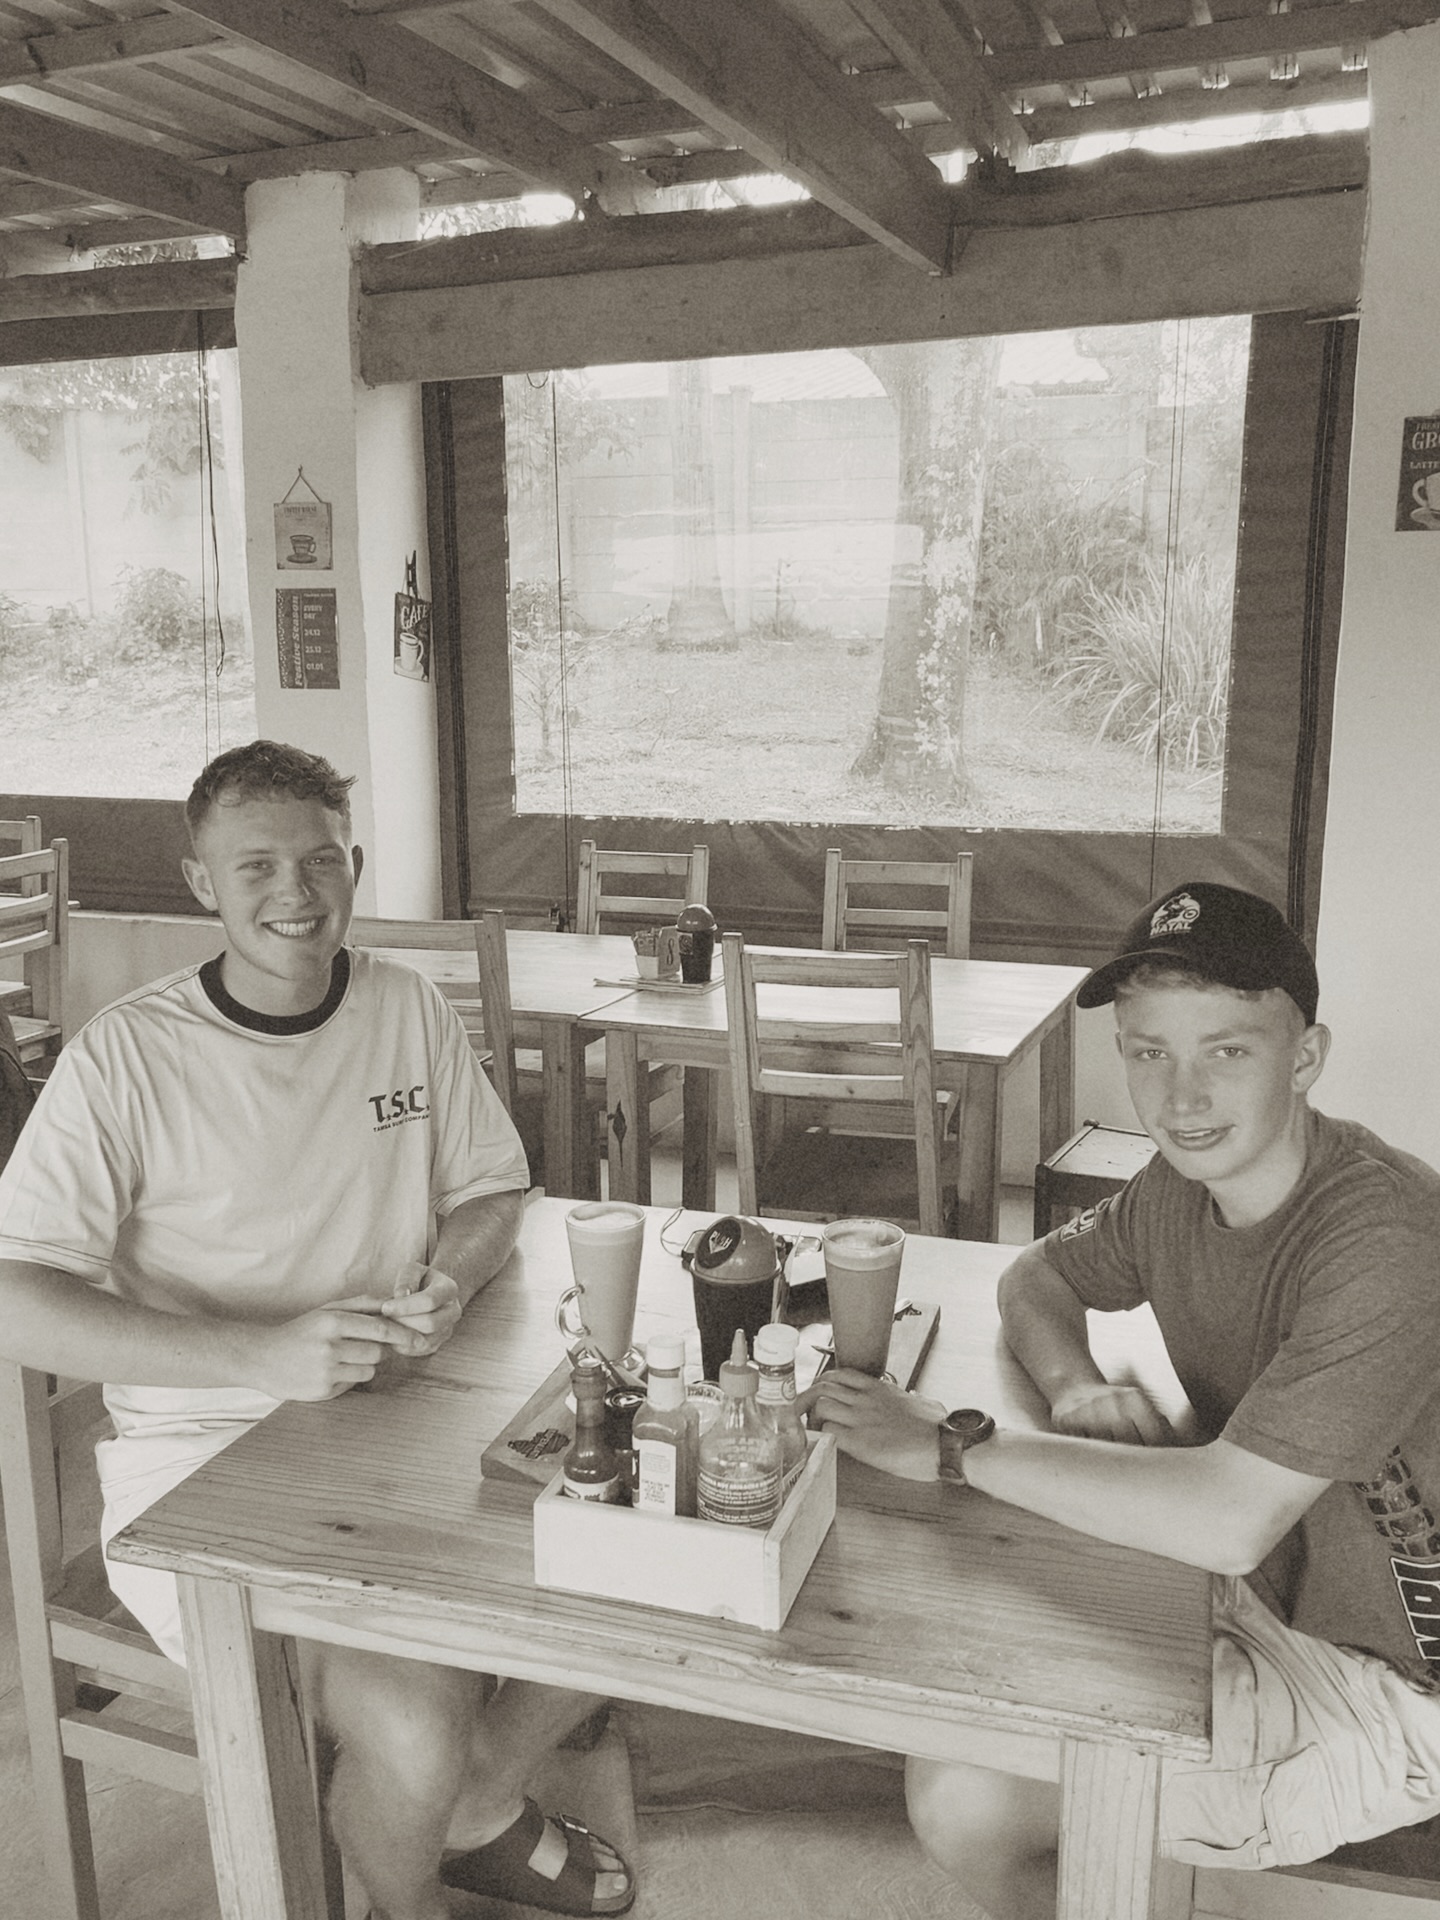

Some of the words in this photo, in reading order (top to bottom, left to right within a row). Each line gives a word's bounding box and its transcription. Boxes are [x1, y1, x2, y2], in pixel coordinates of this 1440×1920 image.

[1412, 431, 1440, 450] GR
[292, 596, 300, 641] Season
[292, 642, 303, 686] Festive
